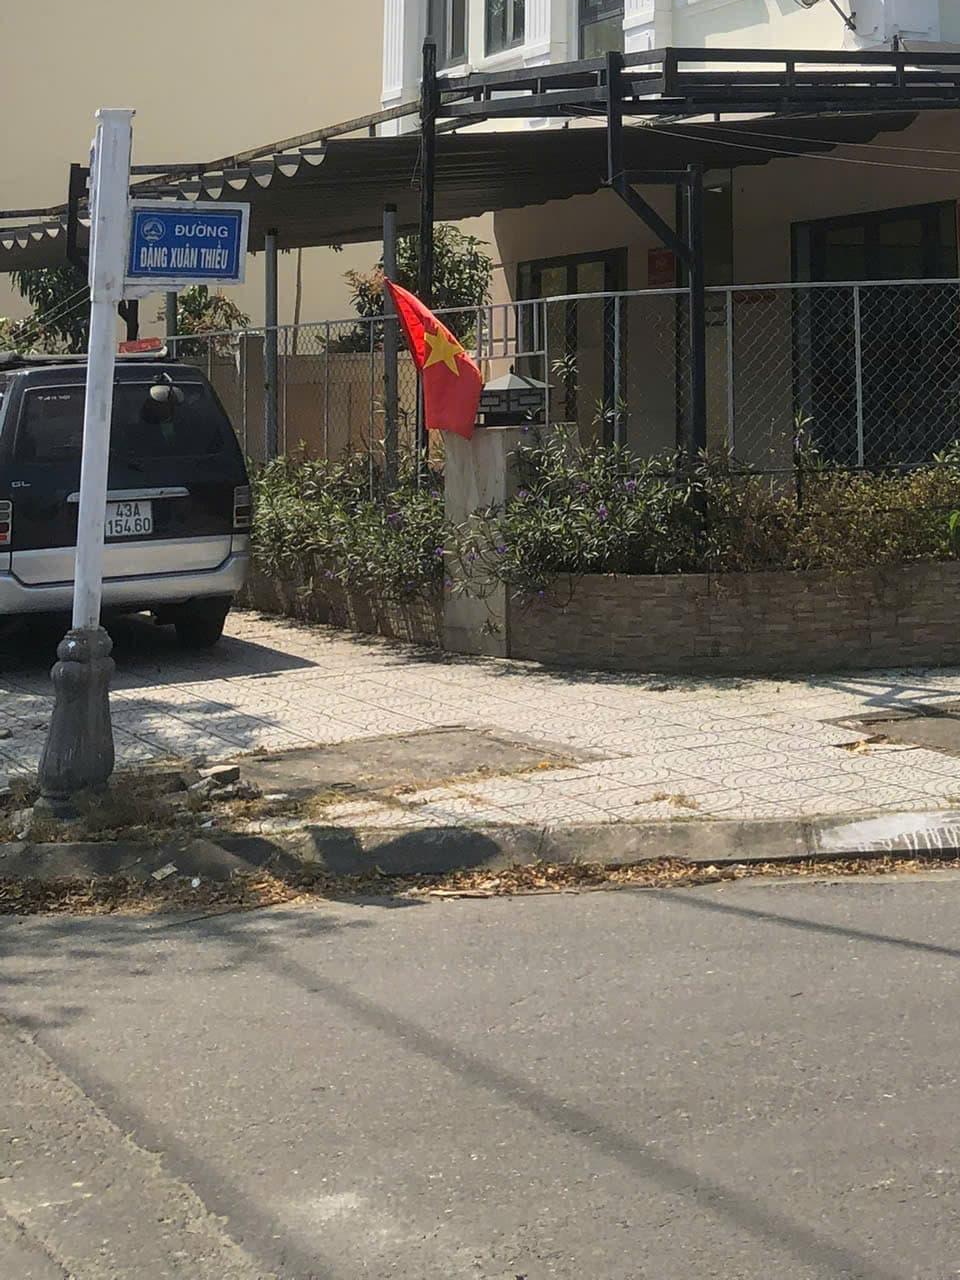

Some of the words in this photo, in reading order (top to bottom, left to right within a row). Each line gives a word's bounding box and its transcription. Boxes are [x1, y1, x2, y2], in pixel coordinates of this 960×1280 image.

[175, 221, 229, 238] ĐƯỜNG
[140, 243, 168, 272] ĐẶNG
[170, 243, 197, 269] XUÂN
[116, 503, 141, 519] 43A
[108, 517, 151, 535] 154.60
